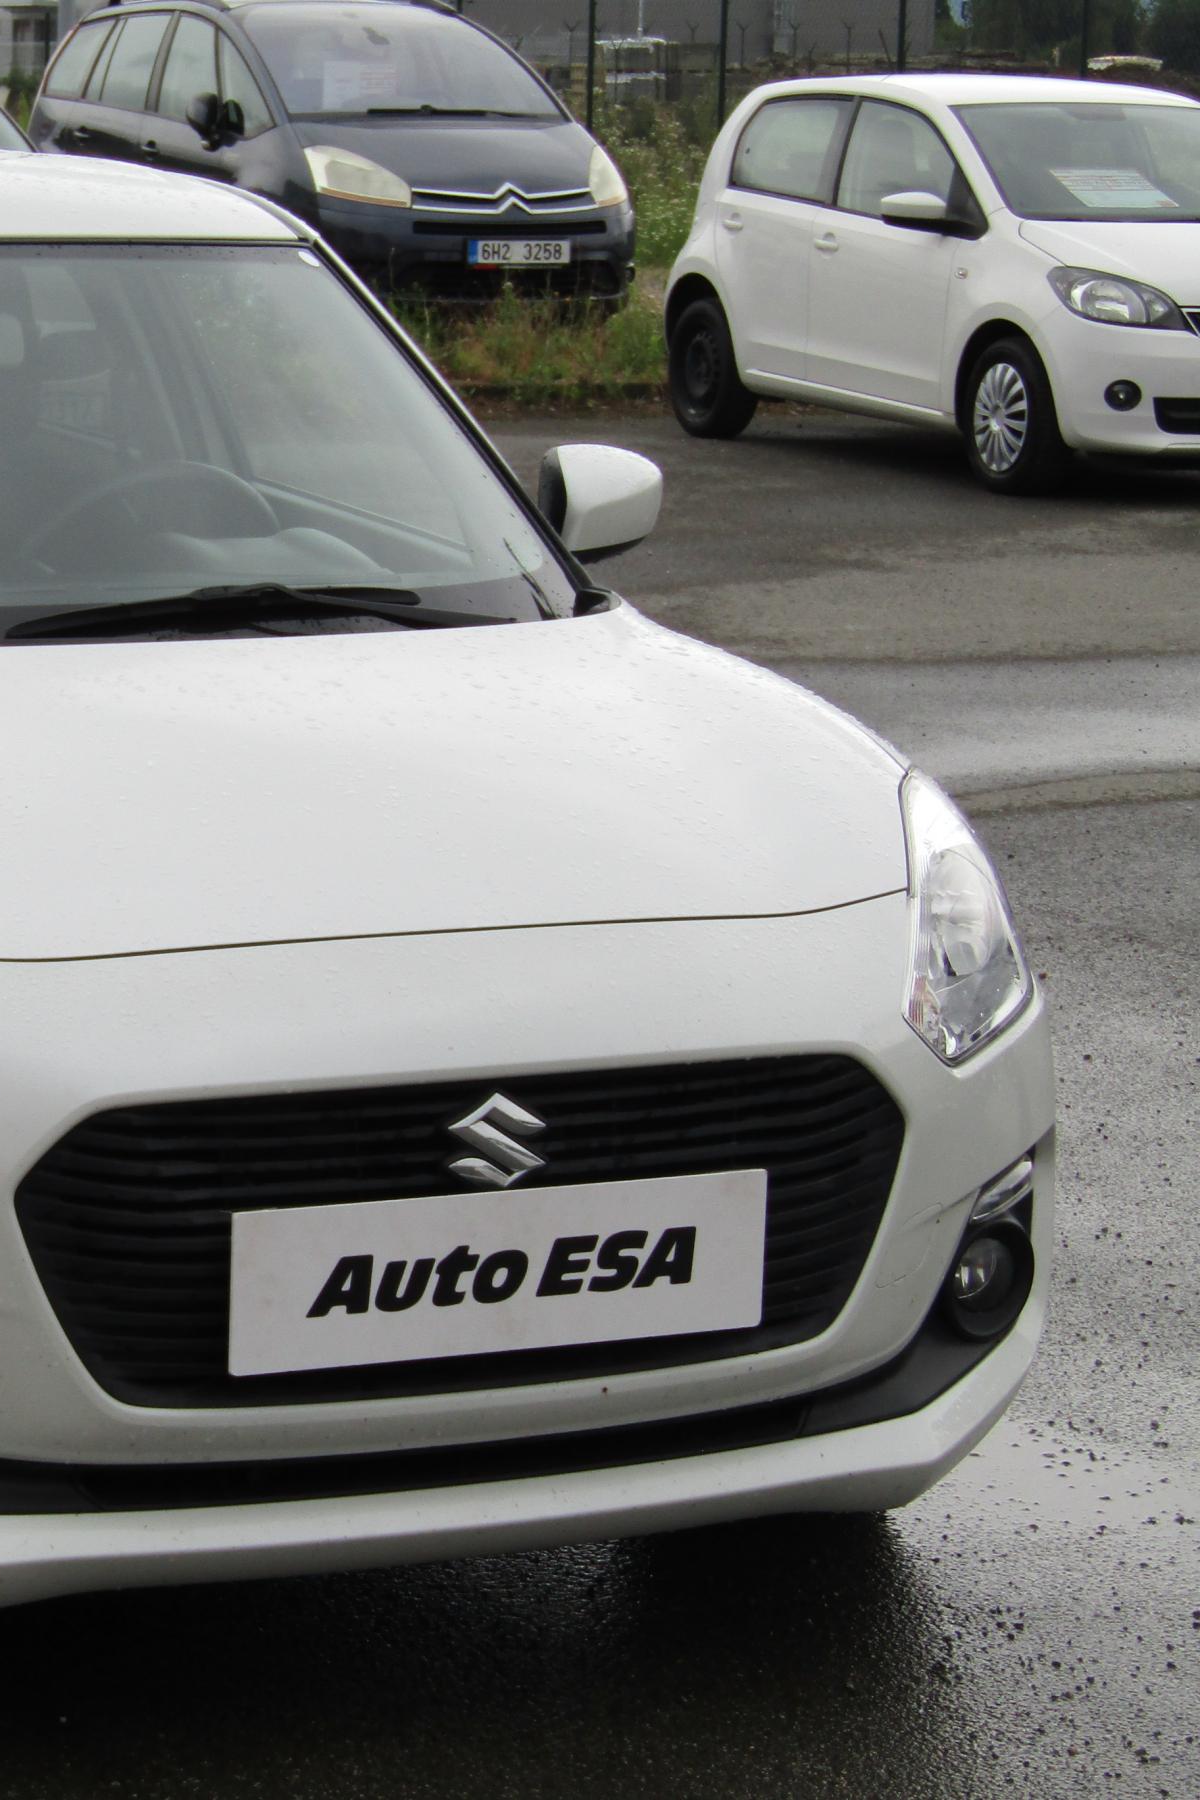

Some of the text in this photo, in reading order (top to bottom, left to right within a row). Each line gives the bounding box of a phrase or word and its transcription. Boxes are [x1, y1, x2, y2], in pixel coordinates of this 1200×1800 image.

[481, 243, 563, 261] 6H2 3258
[305, 1226, 697, 1319] Auto ESA
